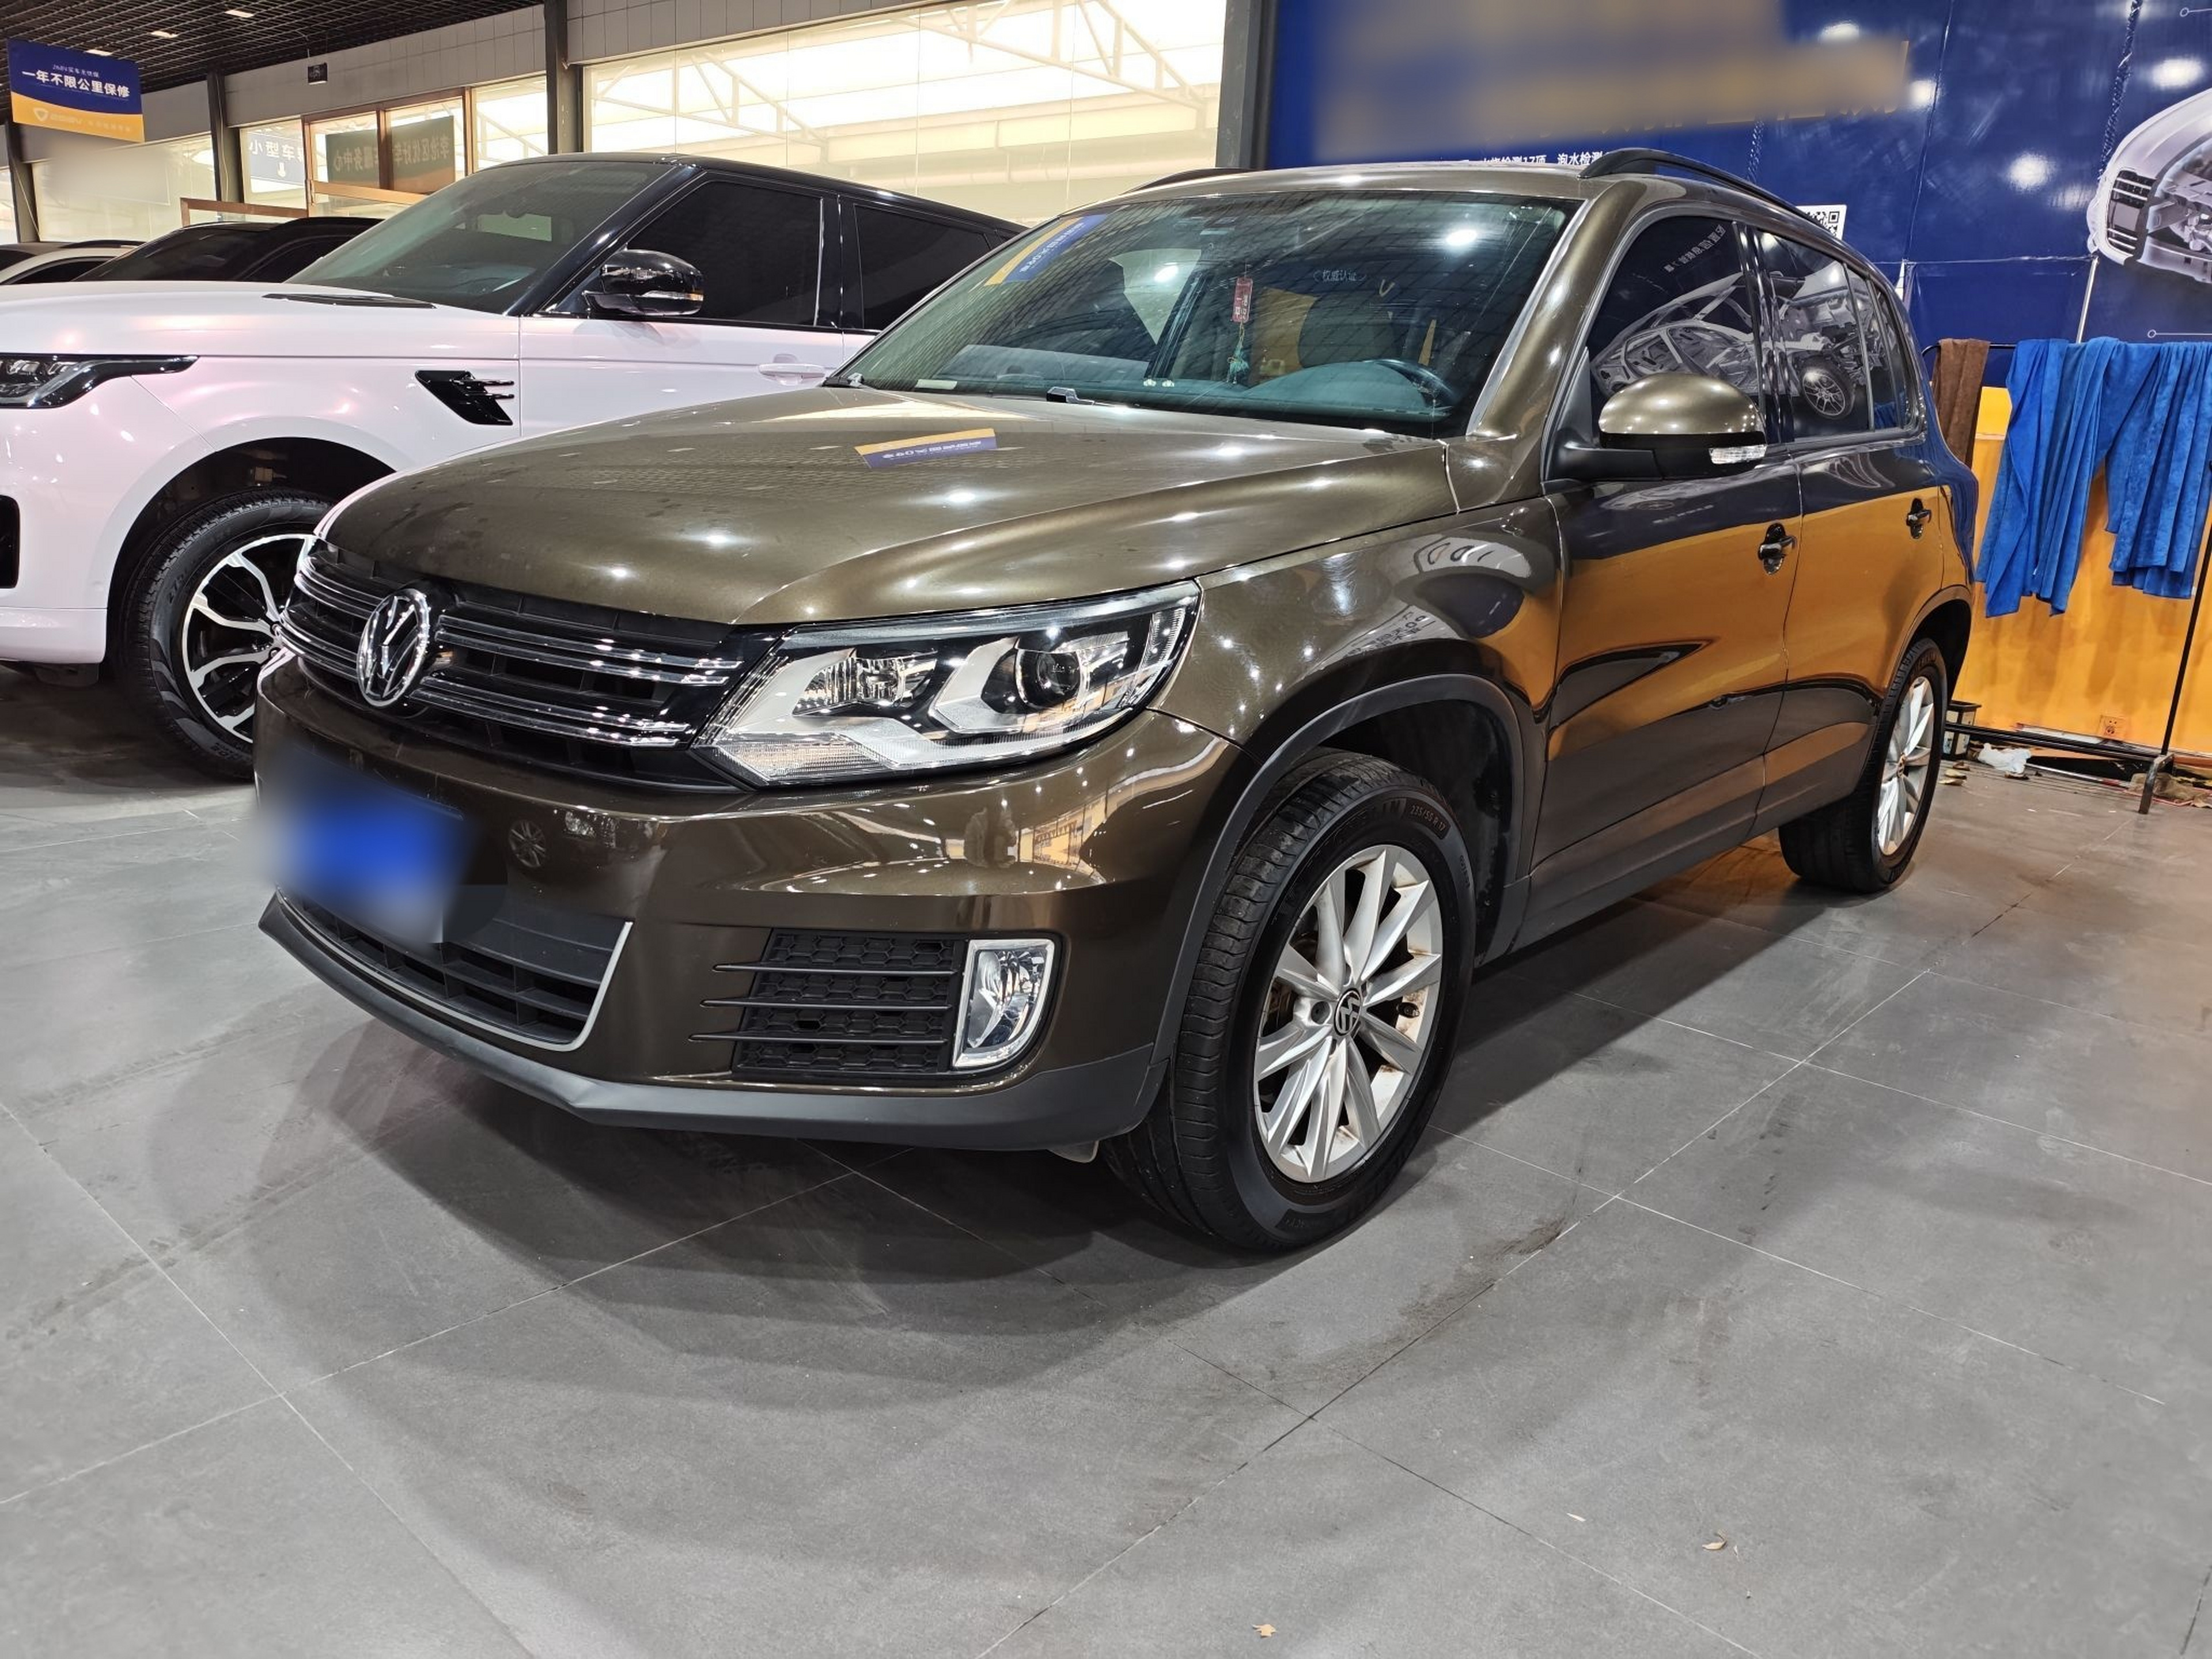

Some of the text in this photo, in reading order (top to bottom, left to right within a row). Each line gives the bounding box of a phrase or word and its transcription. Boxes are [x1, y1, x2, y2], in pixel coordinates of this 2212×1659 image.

[21, 70, 131, 98] 一年不限公里保修
[1557, 151, 1606, 165] 泡水检测
